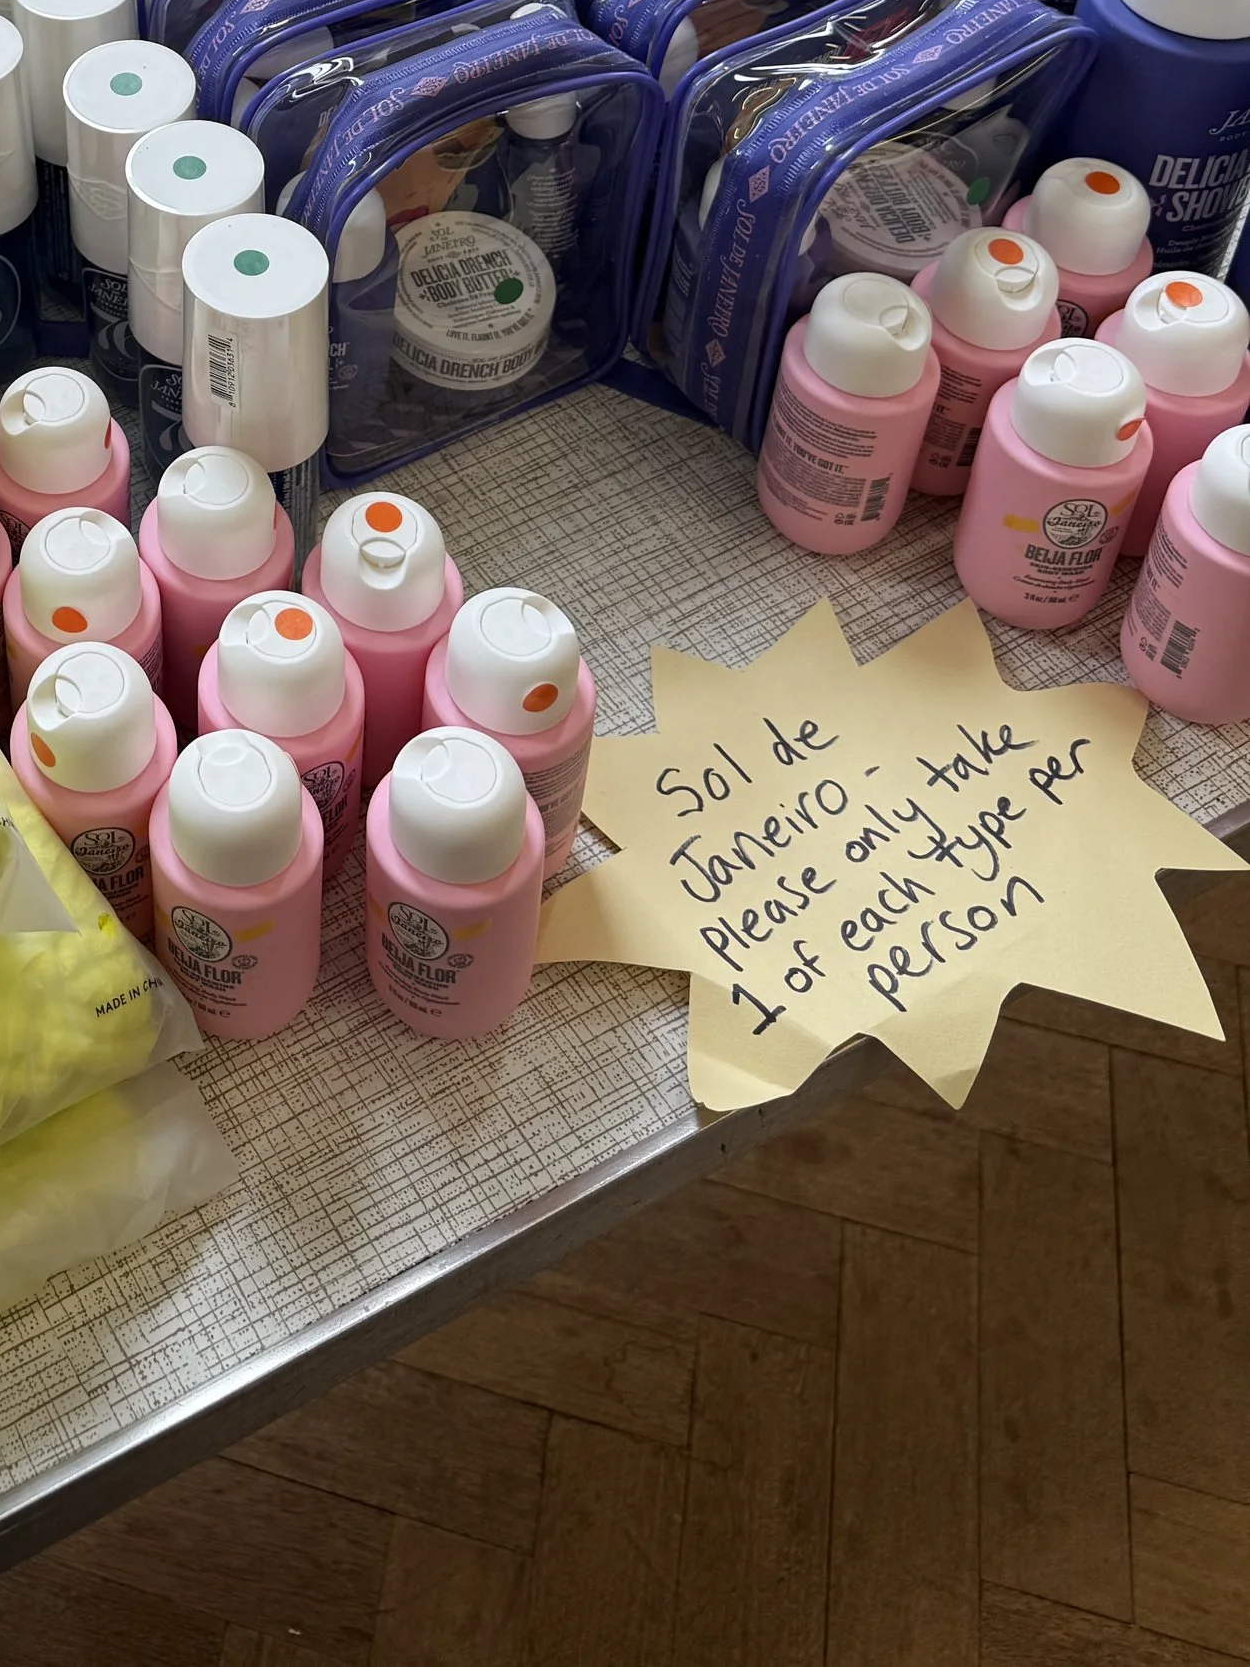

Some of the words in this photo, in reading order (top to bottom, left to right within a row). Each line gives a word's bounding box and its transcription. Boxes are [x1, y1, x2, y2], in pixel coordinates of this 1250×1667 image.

[543, 33, 568, 50] DE
[453, 33, 544, 85] JANEIRO
[885, 62, 912, 83] SOL
[370, 86, 406, 121] SOL
[851, 78, 881, 98] DE
[342, 122, 367, 145] DE
[766, 86, 859, 166] JANEIRO
[430, 226, 454, 242] SOL
[738, 198, 756, 241] SOL
[874, 201, 916, 245] DELICIA
[421, 235, 476, 259] JANEIRO
[727, 243, 746, 271] DE
[410, 263, 460, 288] DELICIA
[458, 250, 512, 277] DRENCH
[426, 280, 464, 303] BODY
[462, 269, 510, 294] BUTTER
[706, 254, 738, 337] JANEIRO
[392, 334, 437, 371] DELICIA
[440, 360, 501, 380] DRENCH
[502, 351, 533, 373] BODY
[793, 442, 817, 465] YOU'VE
[817, 457, 834, 472] GOT
[1047, 515, 1102, 528] Janeiro
[1060, 502, 1092, 517] SOL
[1025, 543, 1066, 566] BEIJA
[1068, 547, 1103, 566] FLOR
[655, 744, 753, 817] Sol
[763, 716, 840, 767] de
[84, 830, 117, 847] SOL
[668, 777, 848, 903] Janeiro
[700, 865, 838, 971] please
[845, 797, 948, 862] only
[916, 723, 1039, 792] take
[109, 866, 145, 888] FLOR
[730, 983, 787, 1034] 1
[783, 939, 827, 994] of
[840, 871, 937, 952] each
[925, 795, 1027, 882] type
[1028, 737, 1091, 805] per
[182, 909, 211, 934] SOL
[400, 905, 430, 932] SOL
[382, 932, 415, 972] BEIJA
[417, 962, 456, 984] FLOR
[864, 875, 1046, 1013] person
[204, 964, 242, 985] FLOR
[95, 994, 127, 1018] MADE
[128, 986, 141, 1001] IN
